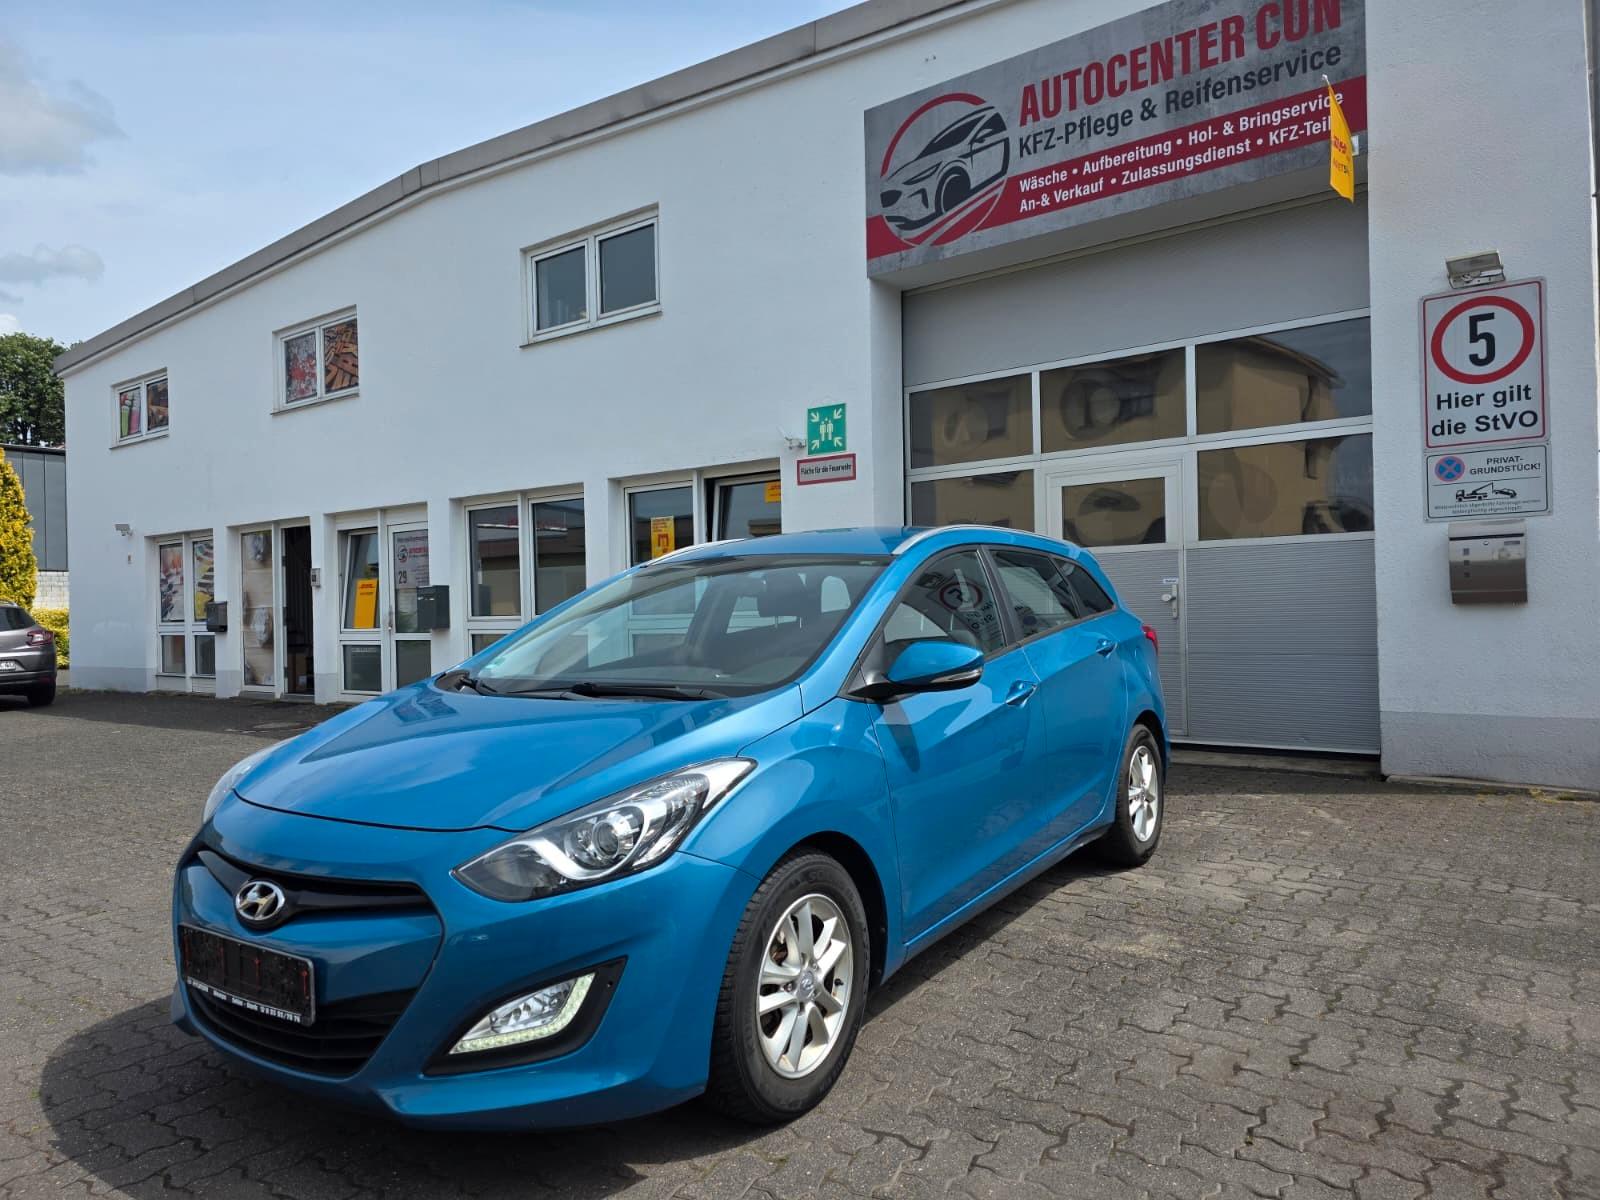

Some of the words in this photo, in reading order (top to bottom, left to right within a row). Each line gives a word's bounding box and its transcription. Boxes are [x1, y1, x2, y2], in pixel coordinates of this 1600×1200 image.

[1019, 14, 1245, 127] AUTOCENTER
[1019, 108, 1134, 158] KFZ-Pflege
[1140, 98, 1158, 121] &
[1165, 45, 1341, 114] Reifenservice
[1019, 170, 1068, 193] Wäsche
[1082, 140, 1172, 175] Aufbereitung
[1188, 125, 1218, 146] Hol-
[1222, 121, 1235, 136] &
[1239, 92, 1344, 132] Bringservice
[1054, 177, 1104, 203] Verkauf
[1121, 138, 1252, 185] Zulassungsdienst
[1269, 115, 1332, 147] KFZ-Teil
[1468, 312, 1496, 367] 5
[1431, 419, 1467, 437] die
[1475, 410, 1538, 432] StVO
[1436, 392, 1485, 410] Hier
[1493, 384, 1532, 408] gilt
[1469, 463, 1541, 475] GRUNDSTÜCK!
[1486, 455, 1524, 465] PRIVAT-
